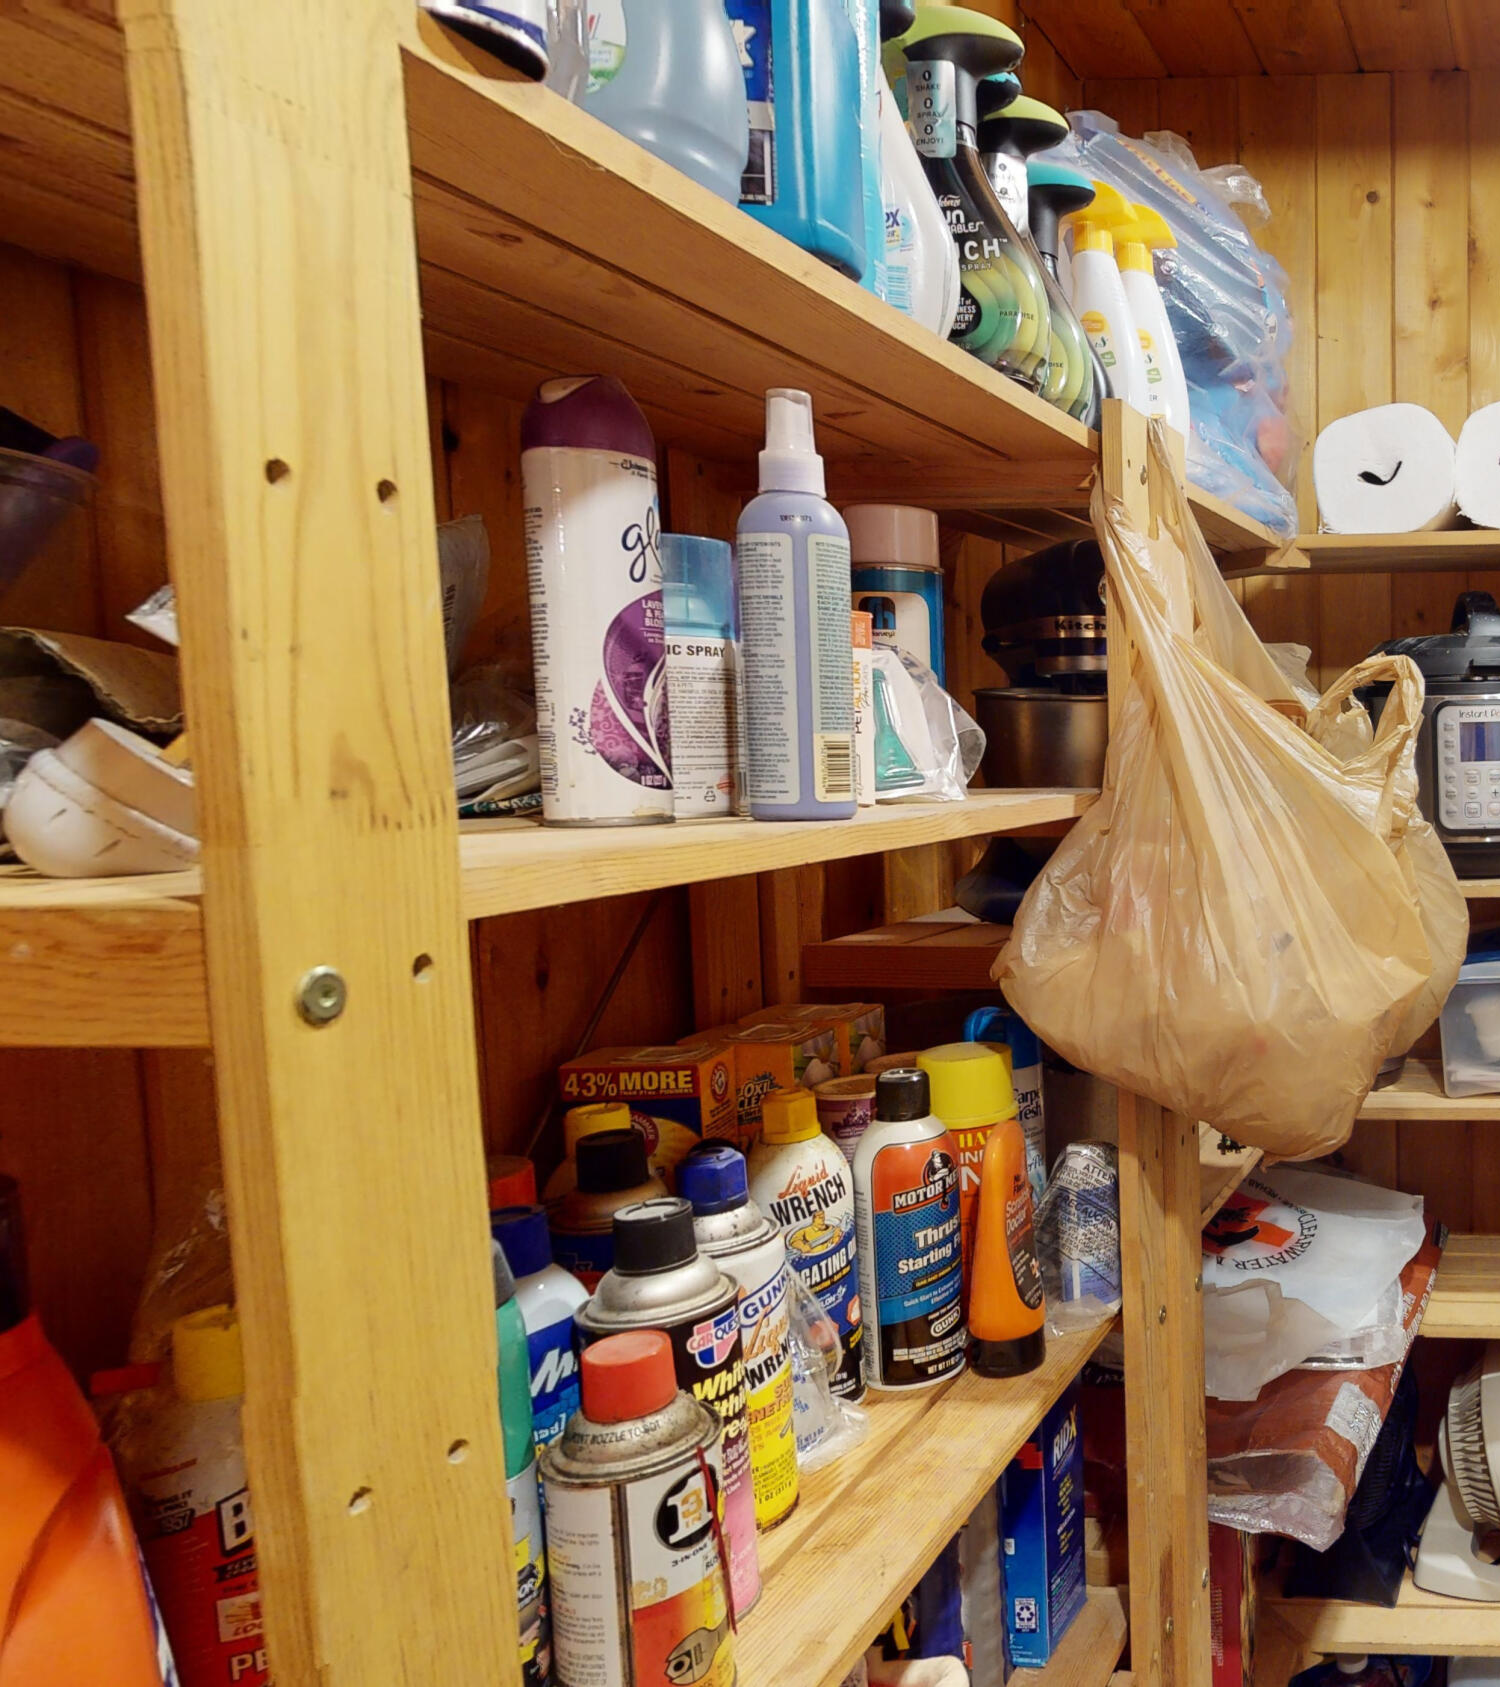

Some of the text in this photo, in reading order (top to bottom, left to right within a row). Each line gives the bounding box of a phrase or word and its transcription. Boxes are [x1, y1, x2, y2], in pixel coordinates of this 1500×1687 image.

[916, 138, 944, 146] ENJOY!
[950, 221, 980, 233] ABLES
[961, 264, 992, 272] SPRAY
[955, 313, 974, 322] VERY
[957, 305, 976, 314] NESS
[667, 645, 725, 658] IC SPRAY
[1459, 709, 1488, 719] Instant
[564, 1071, 617, 1098] 43%
[619, 1070, 692, 1090] MORE
[1018, 1103, 1042, 1121] resh
[631, 1113, 657, 1140] AMMER
[778, 1160, 829, 1200] Liquid
[769, 1172, 847, 1228] WRENCH
[894, 1180, 943, 1209] MOTOR
[914, 1215, 960, 1249] Thrus
[1232, 1213, 1318, 1270] CLEARWATER
[800, 1248, 847, 1288] CATING
[897, 1243, 952, 1274] Starting
[934, 1310, 958, 1333] GUNK
[747, 1332, 791, 1390] WREN
[693, 1360, 745, 1401] Whit
[591, 1427, 627, 1445] NOZZLE
[680, 1486, 704, 1520] 3
[671, 1543, 708, 1567] 3-IN-ONE
